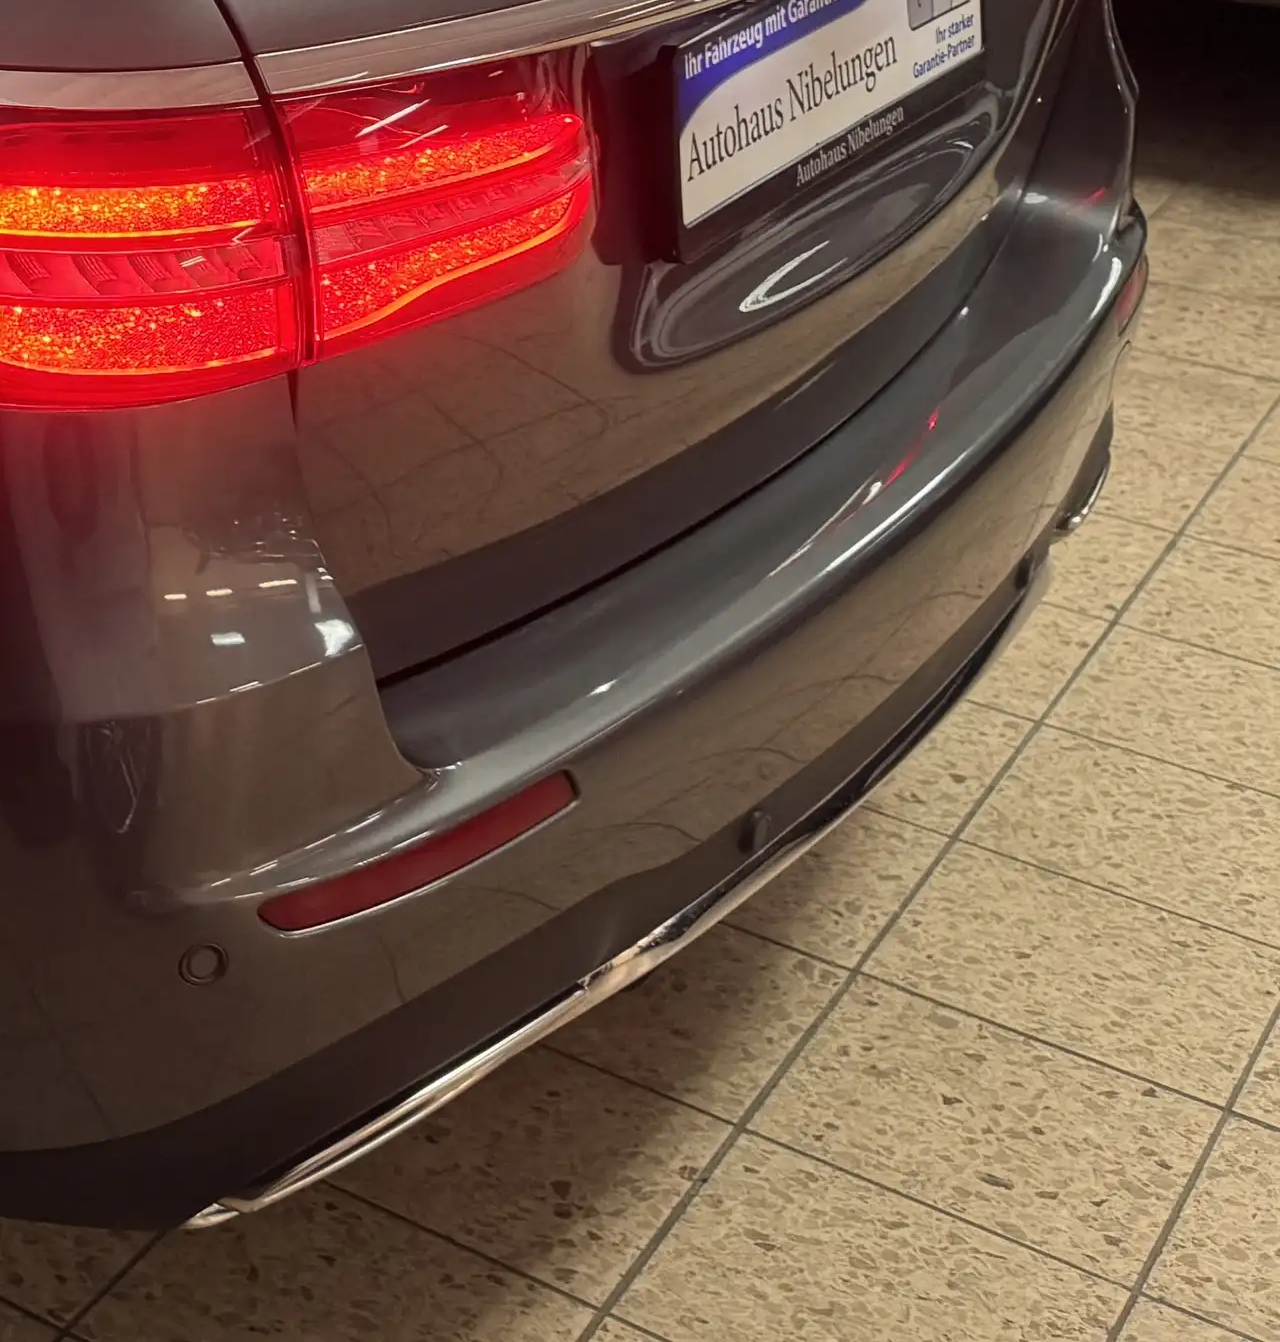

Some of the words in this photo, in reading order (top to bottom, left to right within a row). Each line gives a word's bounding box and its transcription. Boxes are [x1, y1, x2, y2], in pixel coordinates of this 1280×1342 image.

[684, 52, 703, 80] Ihr
[704, 20, 763, 69] Fahrzeug
[764, 5, 787, 37] mit
[912, 34, 975, 78] Garantie-Partner
[935, 25, 946, 45] Ihr
[947, 13, 974, 38] starker
[686, 97, 784, 183] Autohaus
[785, 35, 898, 122] Nibelungen
[795, 140, 847, 187] Autohaus
[847, 105, 905, 156] Nibelungen
